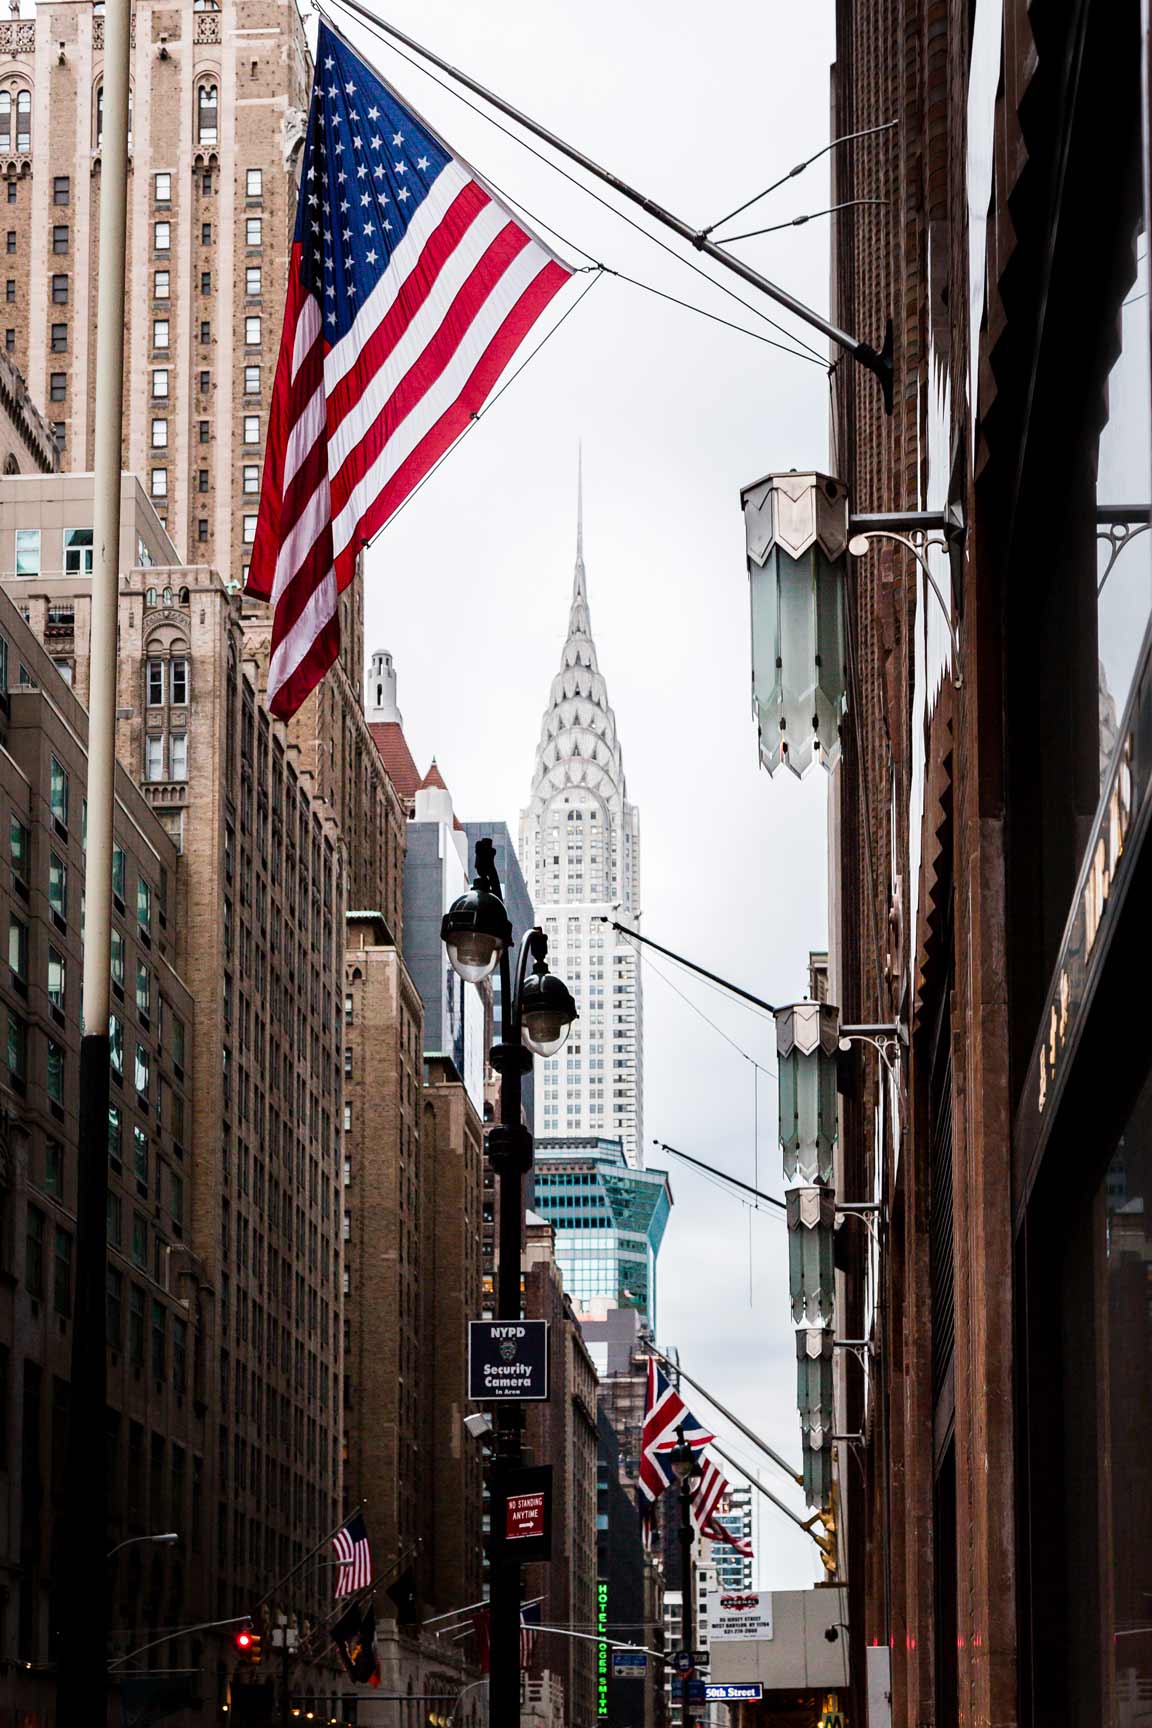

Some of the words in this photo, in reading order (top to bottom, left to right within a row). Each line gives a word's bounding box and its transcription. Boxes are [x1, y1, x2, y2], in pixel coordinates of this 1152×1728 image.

[490, 1327, 526, 1338] NYPD
[483, 1363, 533, 1376] Security
[484, 1376, 531, 1387] Camera
[508, 1500, 517, 1510] NO
[518, 1497, 543, 1509] STANDING
[512, 1509, 539, 1520] ANYTIME
[598, 1584, 608, 1632] HOTEL
[598, 1677, 608, 1714] SMITH
[705, 1688, 726, 1697] 50th
[727, 1687, 756, 1697] Street
